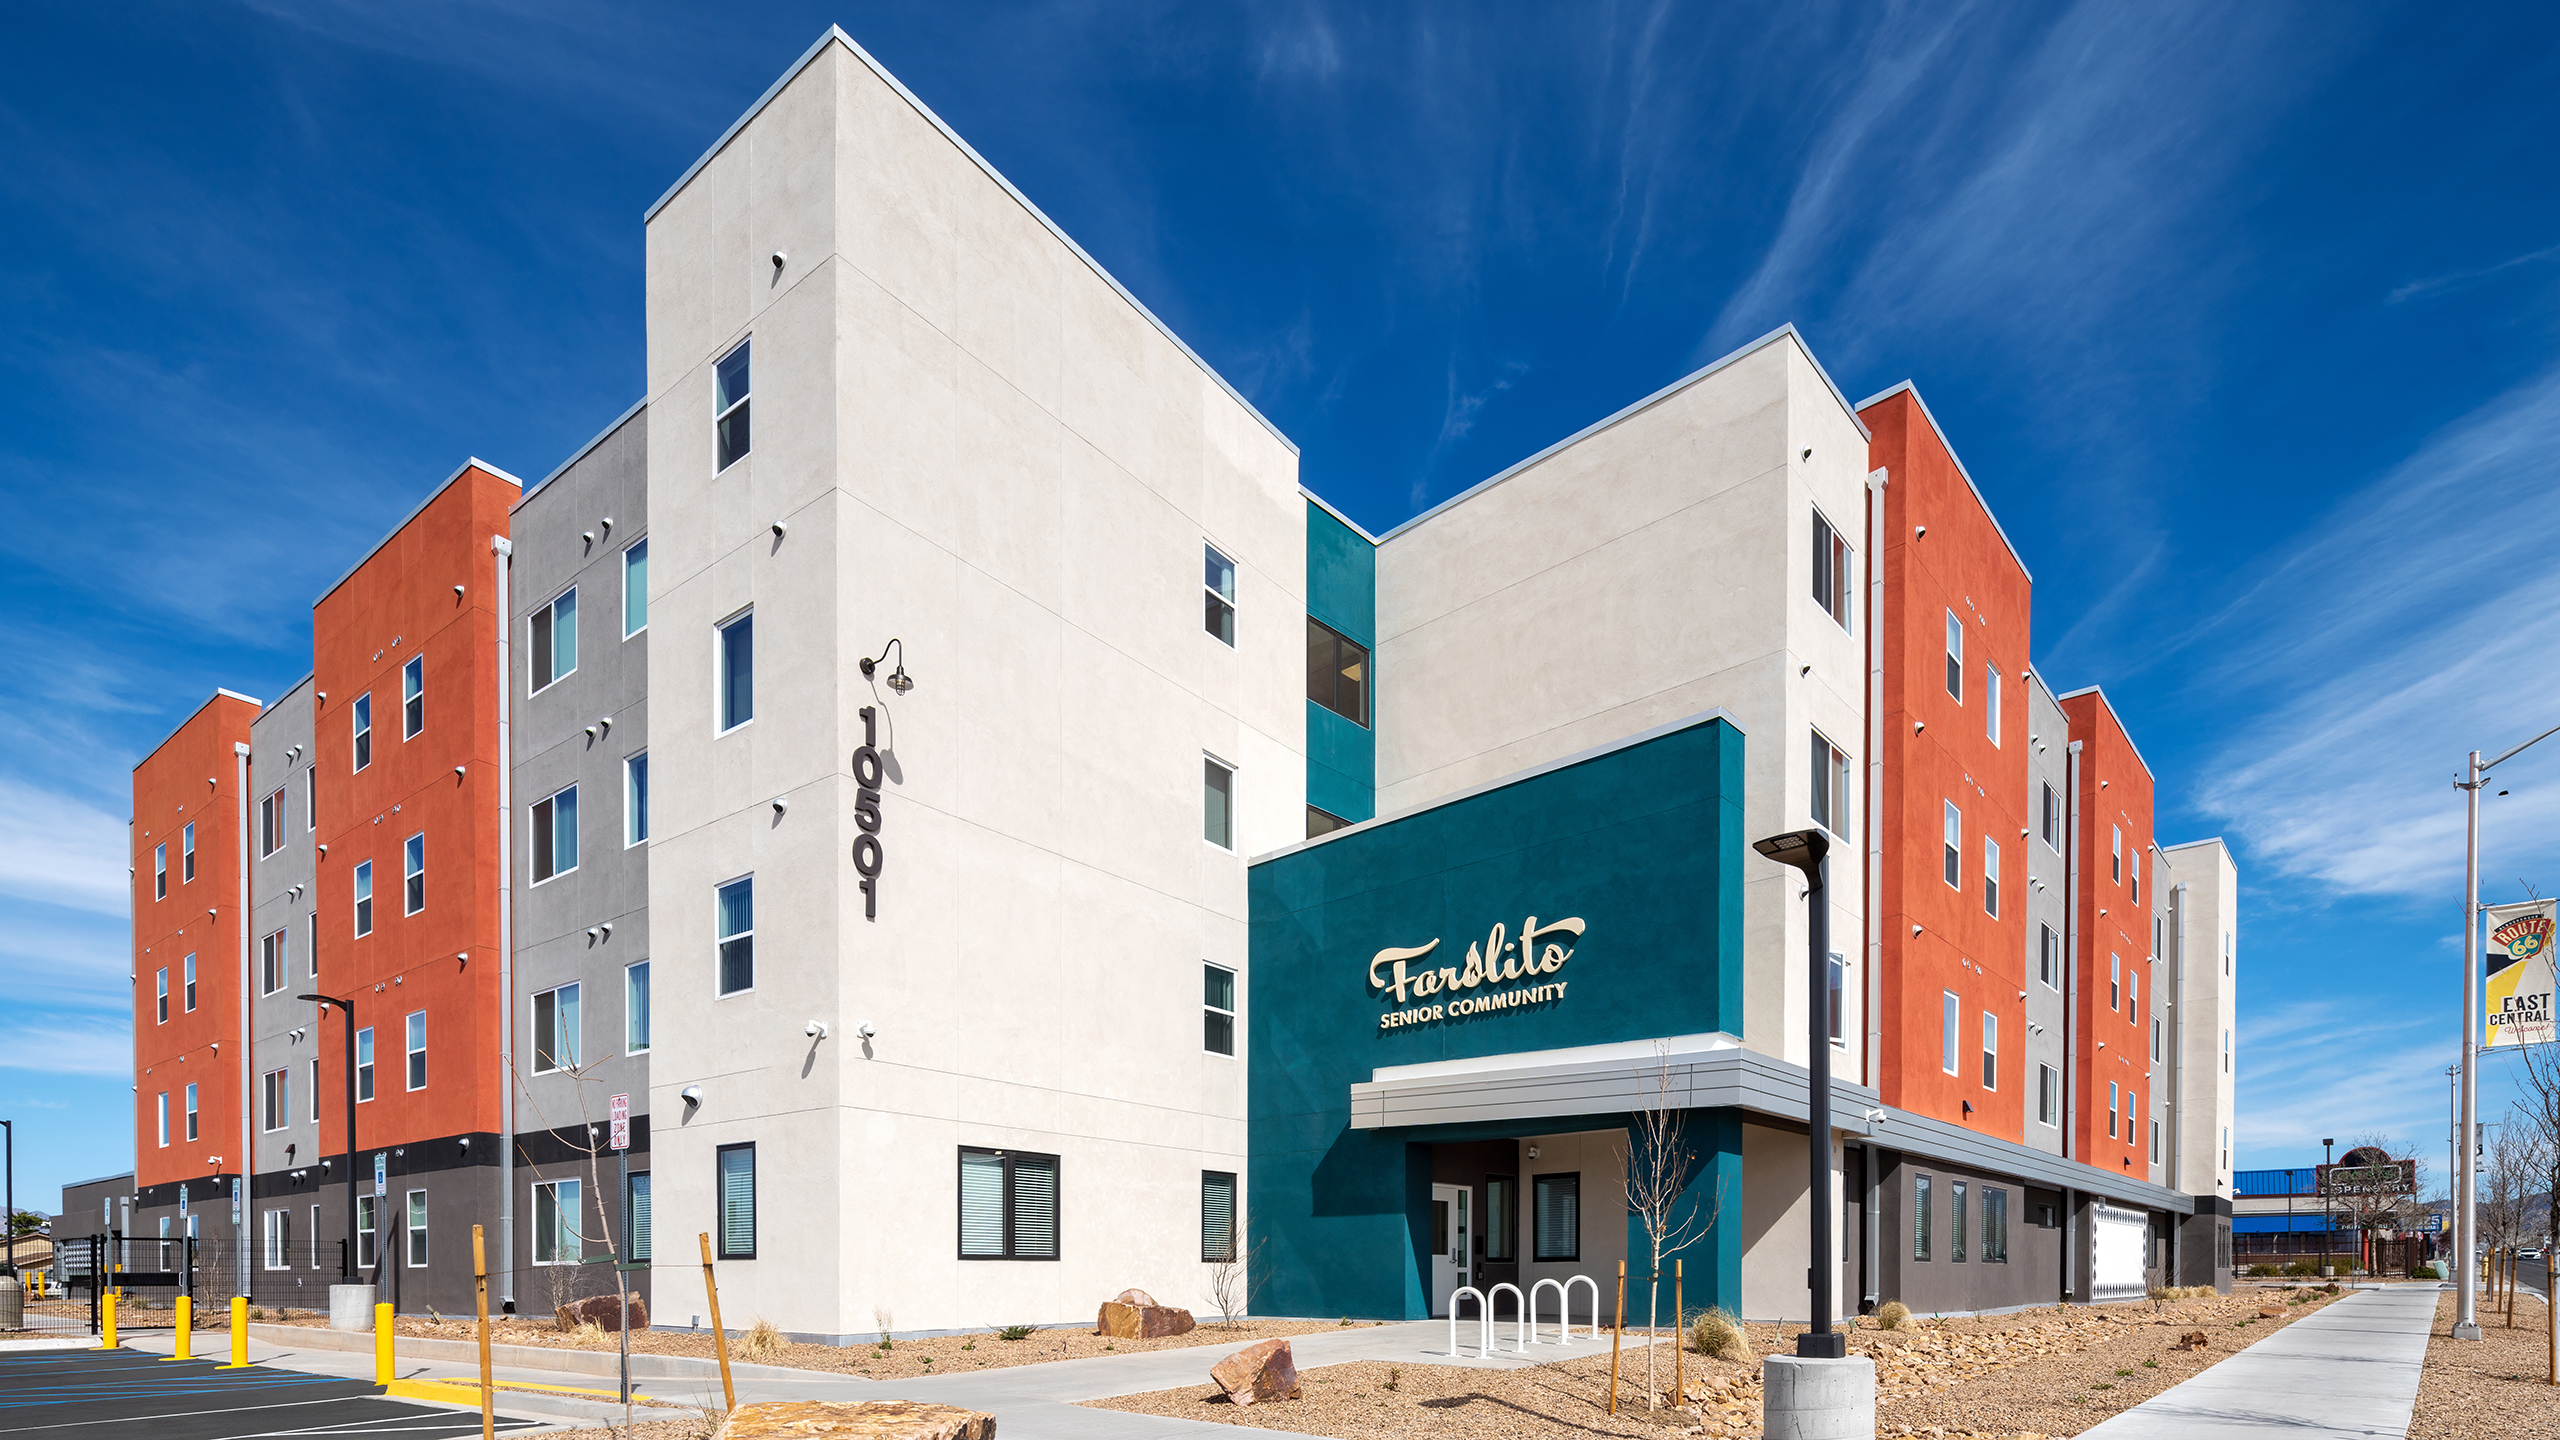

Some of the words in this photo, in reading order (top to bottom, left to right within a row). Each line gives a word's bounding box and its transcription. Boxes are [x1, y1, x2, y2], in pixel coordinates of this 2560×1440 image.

[852, 705, 883, 918] 10501
[2496, 920, 2546, 944] ROUTE
[2512, 935, 2538, 955] 66
[1380, 1004, 1444, 1029] SENIOR
[1447, 981, 1568, 1017] COMMUNITY
[2503, 992, 2551, 1013] EAST
[2489, 1009, 2551, 1026] CENTRAL
[2320, 1183, 2410, 1195] DSPENSARY
